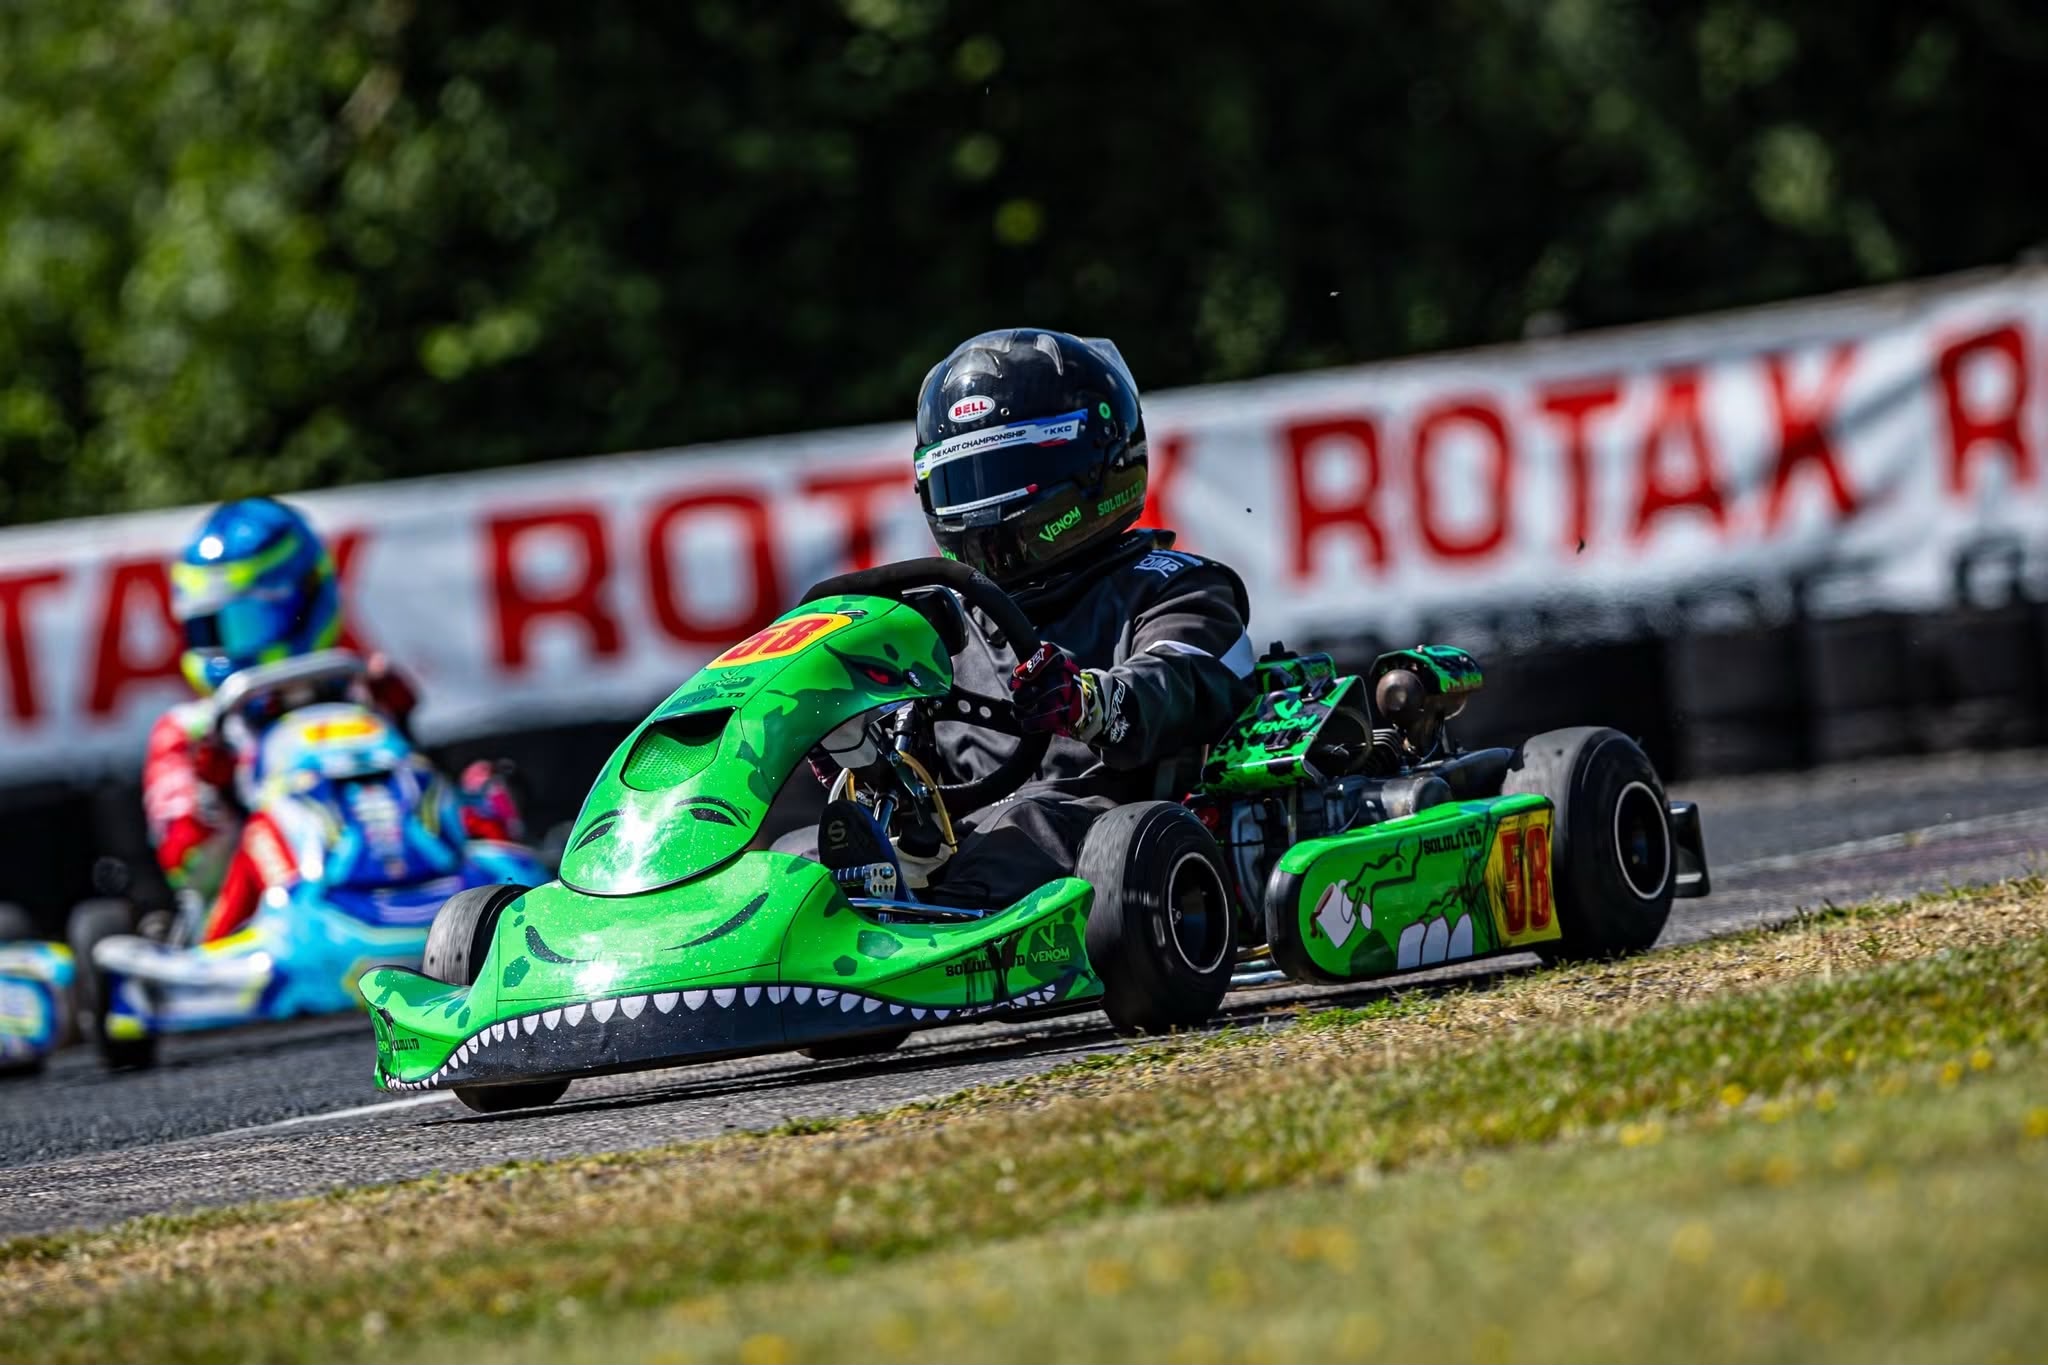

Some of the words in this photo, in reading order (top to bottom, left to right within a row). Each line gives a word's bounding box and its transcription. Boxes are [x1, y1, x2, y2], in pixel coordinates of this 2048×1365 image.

[954, 401, 988, 416] BELL
[931, 450, 941, 460] THE
[942, 444, 961, 456] KART
[961, 429, 1027, 449] CHAMPIONSHIP
[1280, 343, 1860, 582] ROTAK
[1038, 505, 1082, 543] VENOM
[1138, 555, 1180, 573] OMP
[717, 617, 834, 663] 58
[716, 691, 745, 699] LTD
[1239, 713, 1319, 739] VENOM
[1423, 833, 1461, 855] SOLULI
[1499, 825, 1552, 937] 58
[1030, 947, 1070, 962] VENOM
